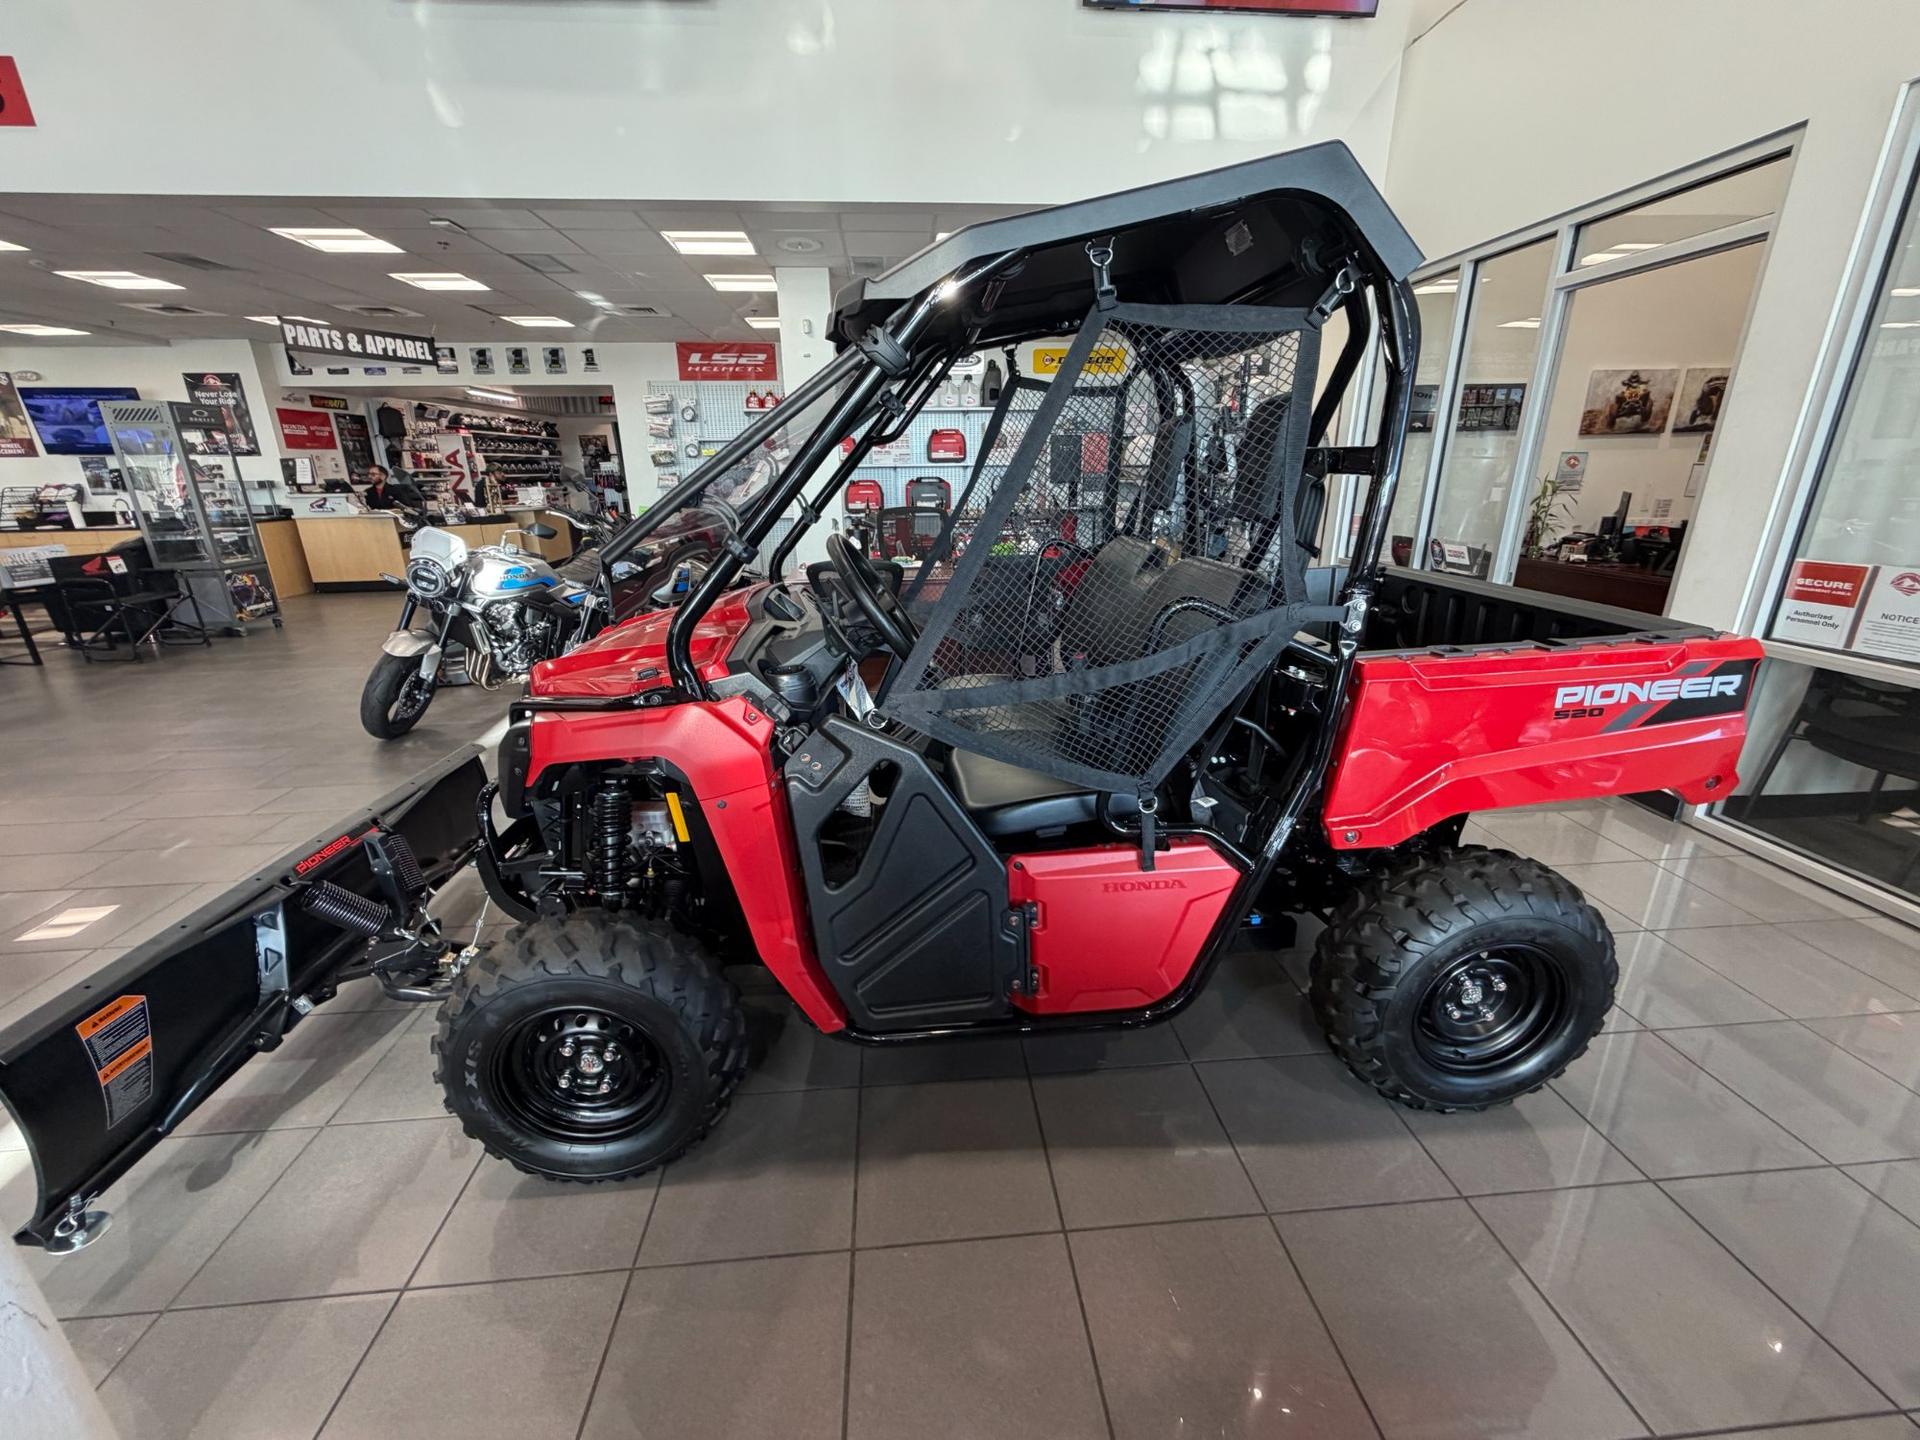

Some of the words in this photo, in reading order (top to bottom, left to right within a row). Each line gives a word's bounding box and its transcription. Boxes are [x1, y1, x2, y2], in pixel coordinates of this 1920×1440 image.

[282, 323, 344, 351] PARTS
[346, 332, 363, 353] &
[364, 334, 433, 361] APPAREL
[687, 352, 768, 365] LS2
[1796, 578, 1855, 591] SECURE
[1793, 610, 1833, 621] Authorized
[1880, 613, 1920, 624] NOTICE
[1786, 615, 1820, 626] Personnel
[1821, 620, 1840, 630] Only
[1554, 674, 1744, 709] PIONEER
[1553, 707, 1605, 720] 520
[295, 835, 351, 874] PIONEER
[1102, 879, 1187, 893] HONDA
